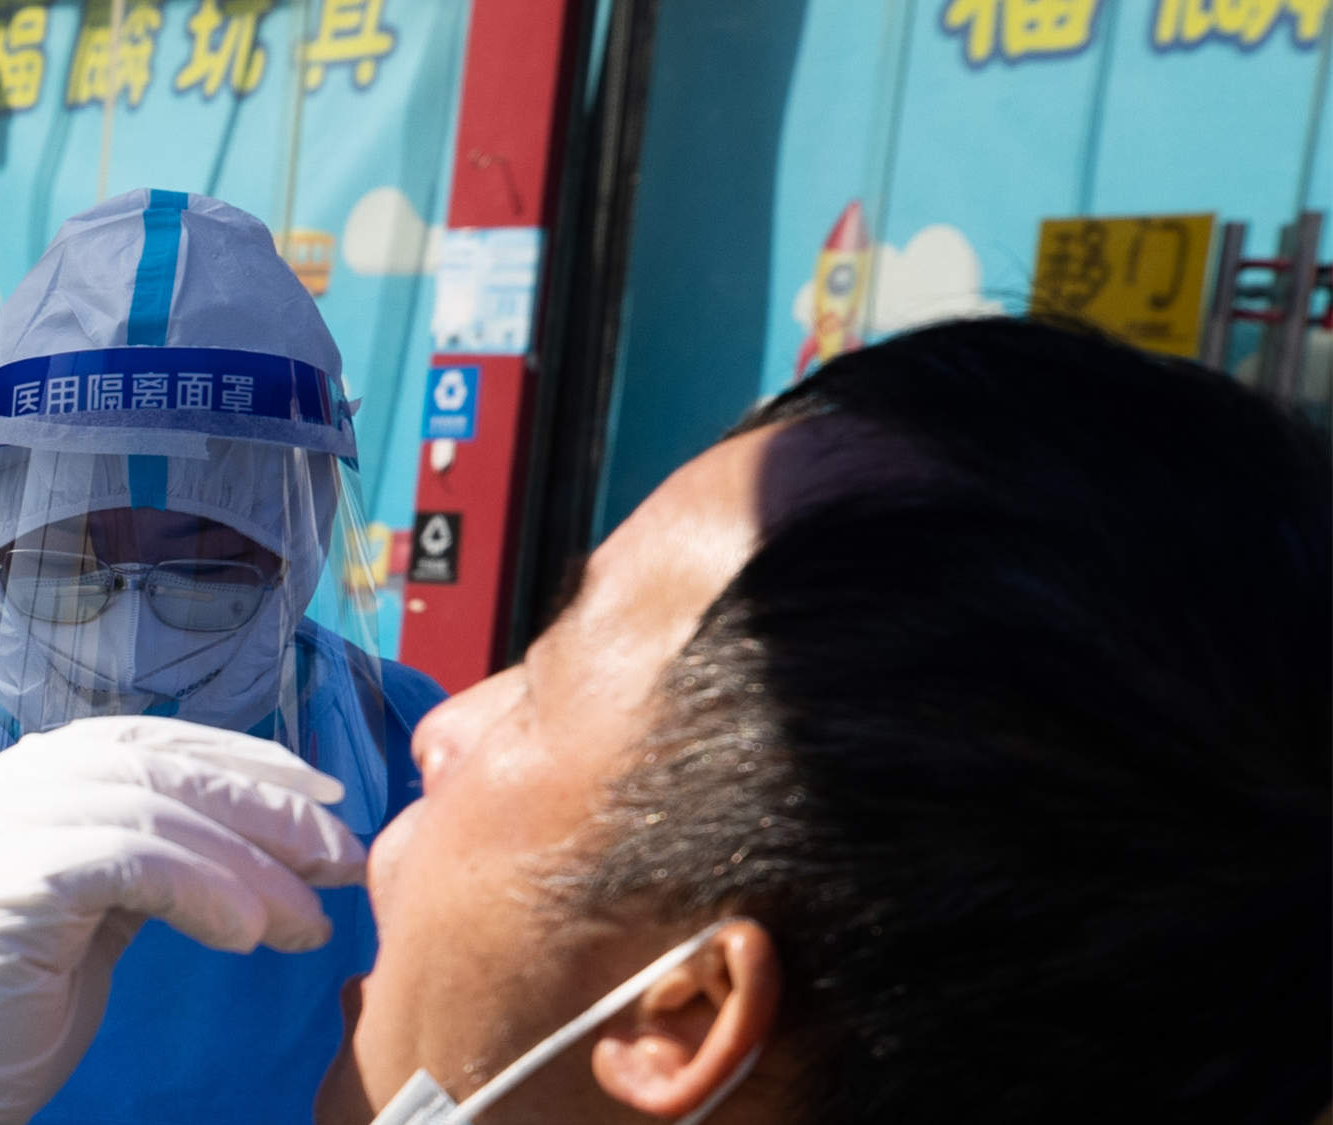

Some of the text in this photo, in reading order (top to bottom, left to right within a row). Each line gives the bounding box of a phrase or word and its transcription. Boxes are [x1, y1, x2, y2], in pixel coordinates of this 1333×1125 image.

[12, 371, 254, 417] 医用隔离面罩
